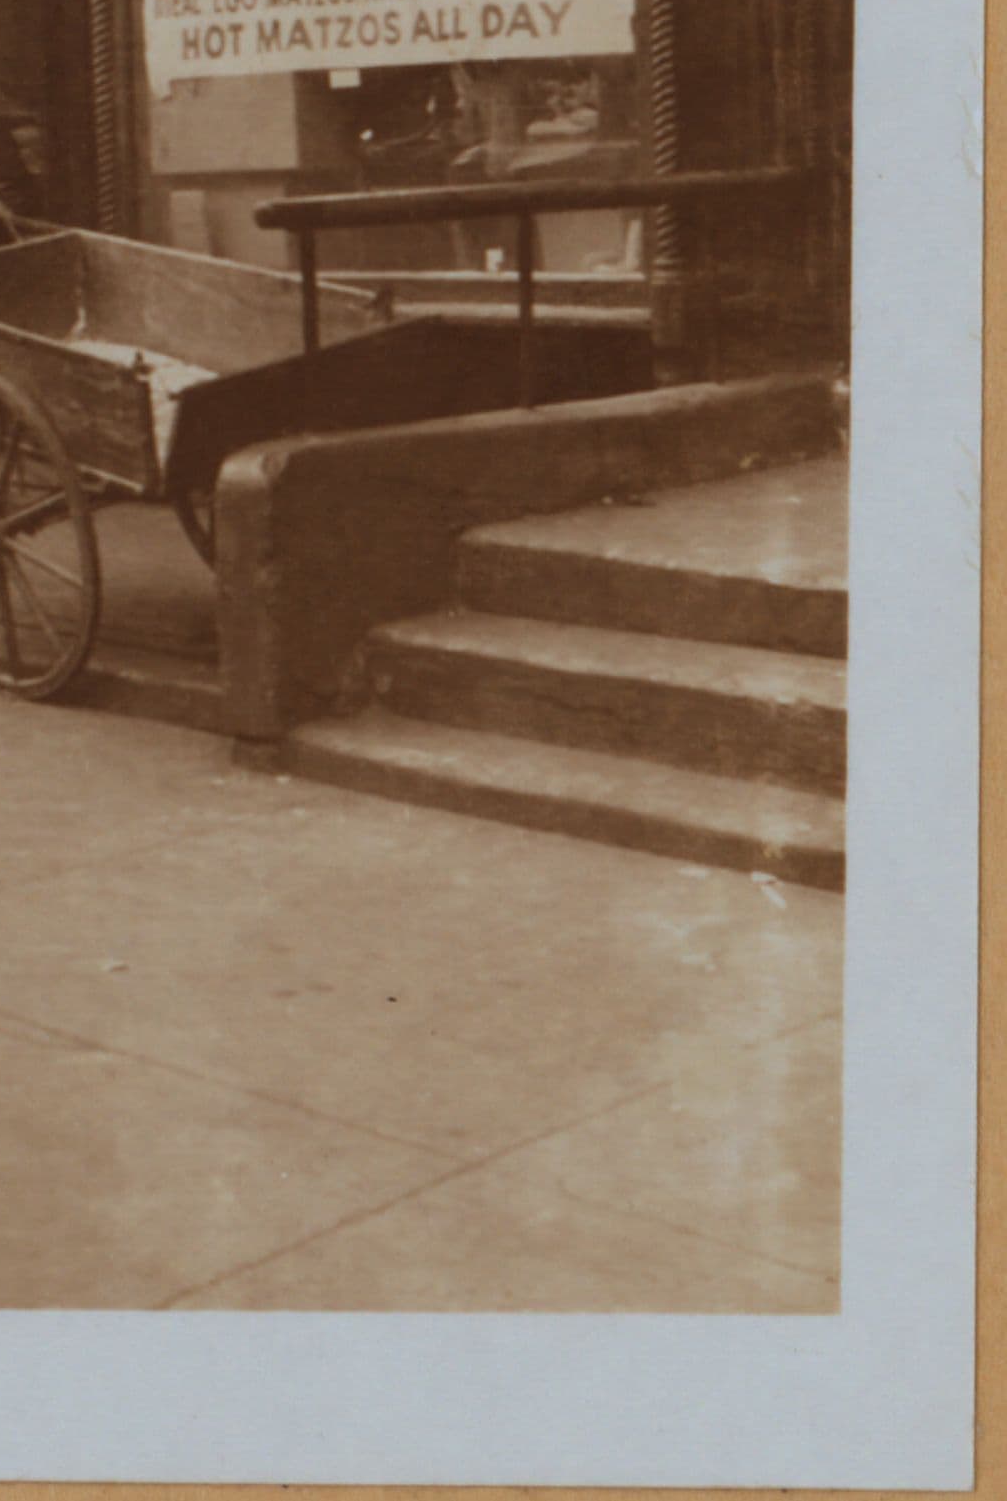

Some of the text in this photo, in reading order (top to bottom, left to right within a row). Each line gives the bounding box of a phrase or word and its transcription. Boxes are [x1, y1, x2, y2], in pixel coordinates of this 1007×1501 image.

[181, 0, 574, 61] HOT MATZOS ALL DAY
